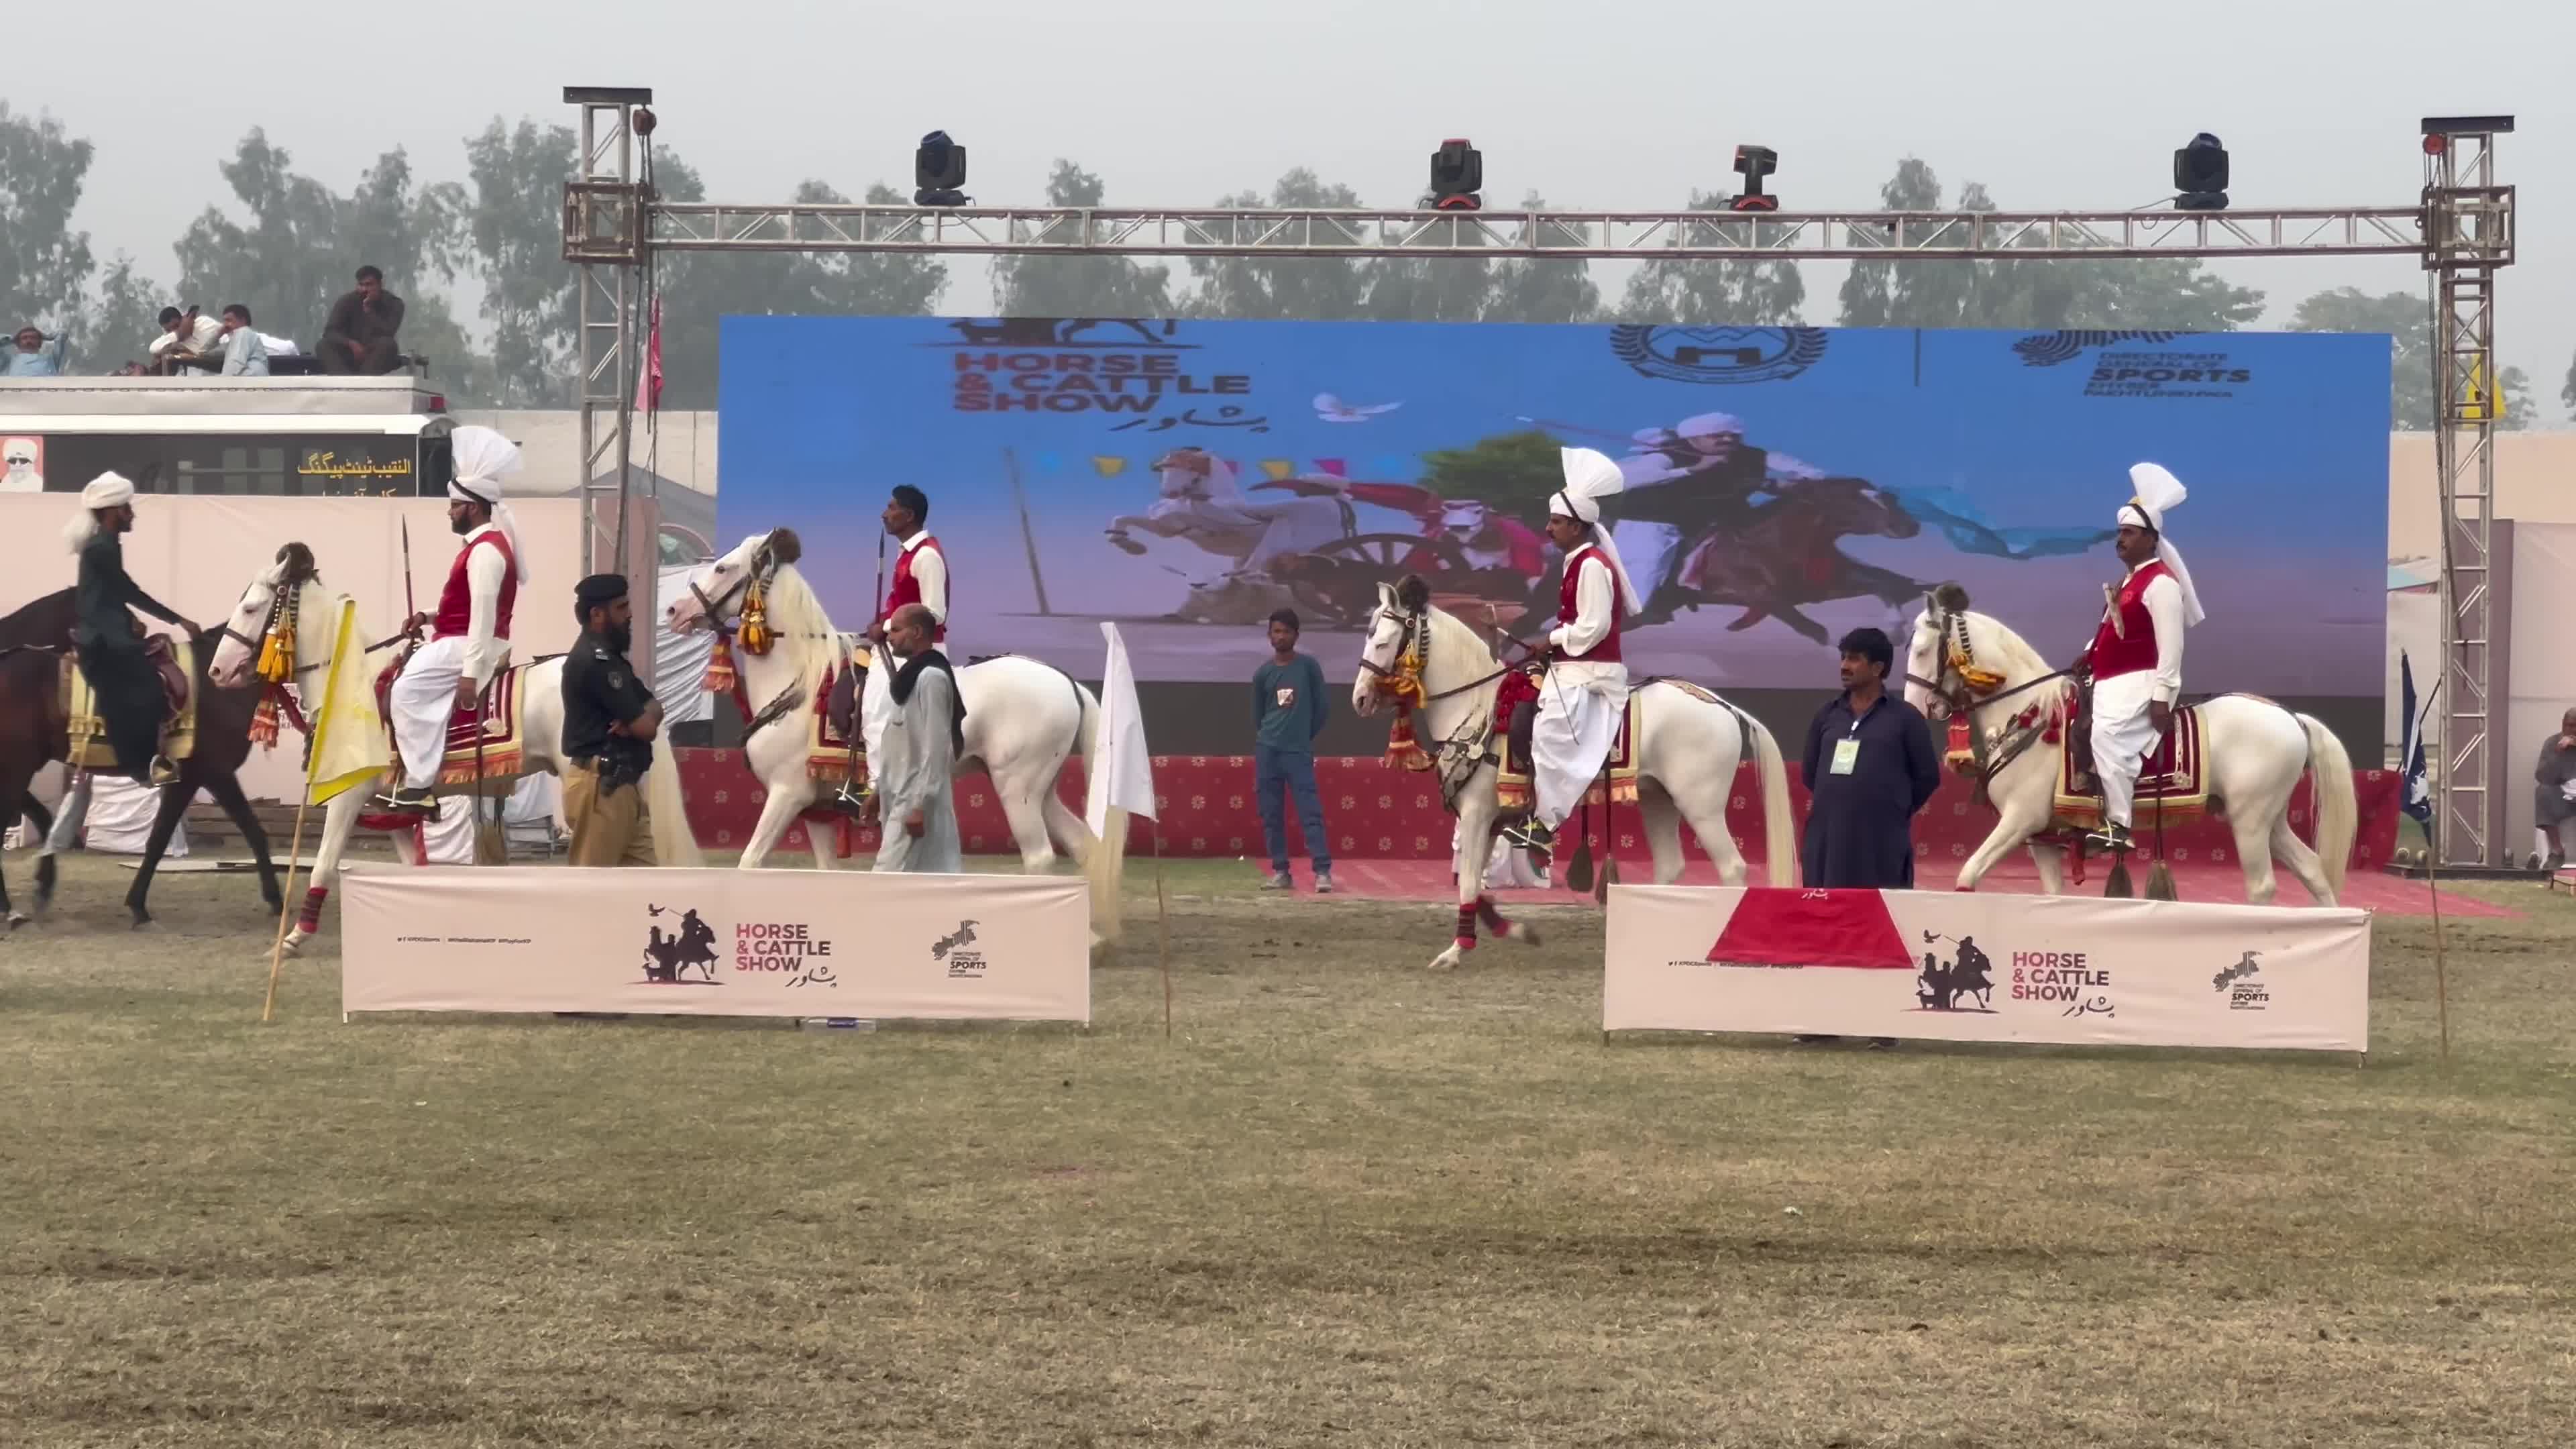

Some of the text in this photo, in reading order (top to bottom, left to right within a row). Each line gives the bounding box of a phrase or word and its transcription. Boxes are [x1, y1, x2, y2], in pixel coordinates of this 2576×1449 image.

[954, 353, 1179, 373] HORSE
[953, 373, 1251, 394] & CATTLE
[2089, 368, 2251, 382] SPORTS
[953, 393, 1161, 413] SHOW
[1108, 405, 1271, 432] پشاور
[736, 922, 808, 940] HORSE
[736, 939, 831, 956] & CATTLE
[735, 956, 802, 972] SHOW
[950, 961, 987, 969] SPORTS
[2012, 951, 2087, 969] HORSE
[785, 966, 837, 987] پشاور
[2012, 968, 2110, 986] & CATTLE
[2011, 984, 2080, 1002] SHOW
[2231, 993, 2270, 1002] SPORTS
[2061, 996, 2115, 1018] پشاور
